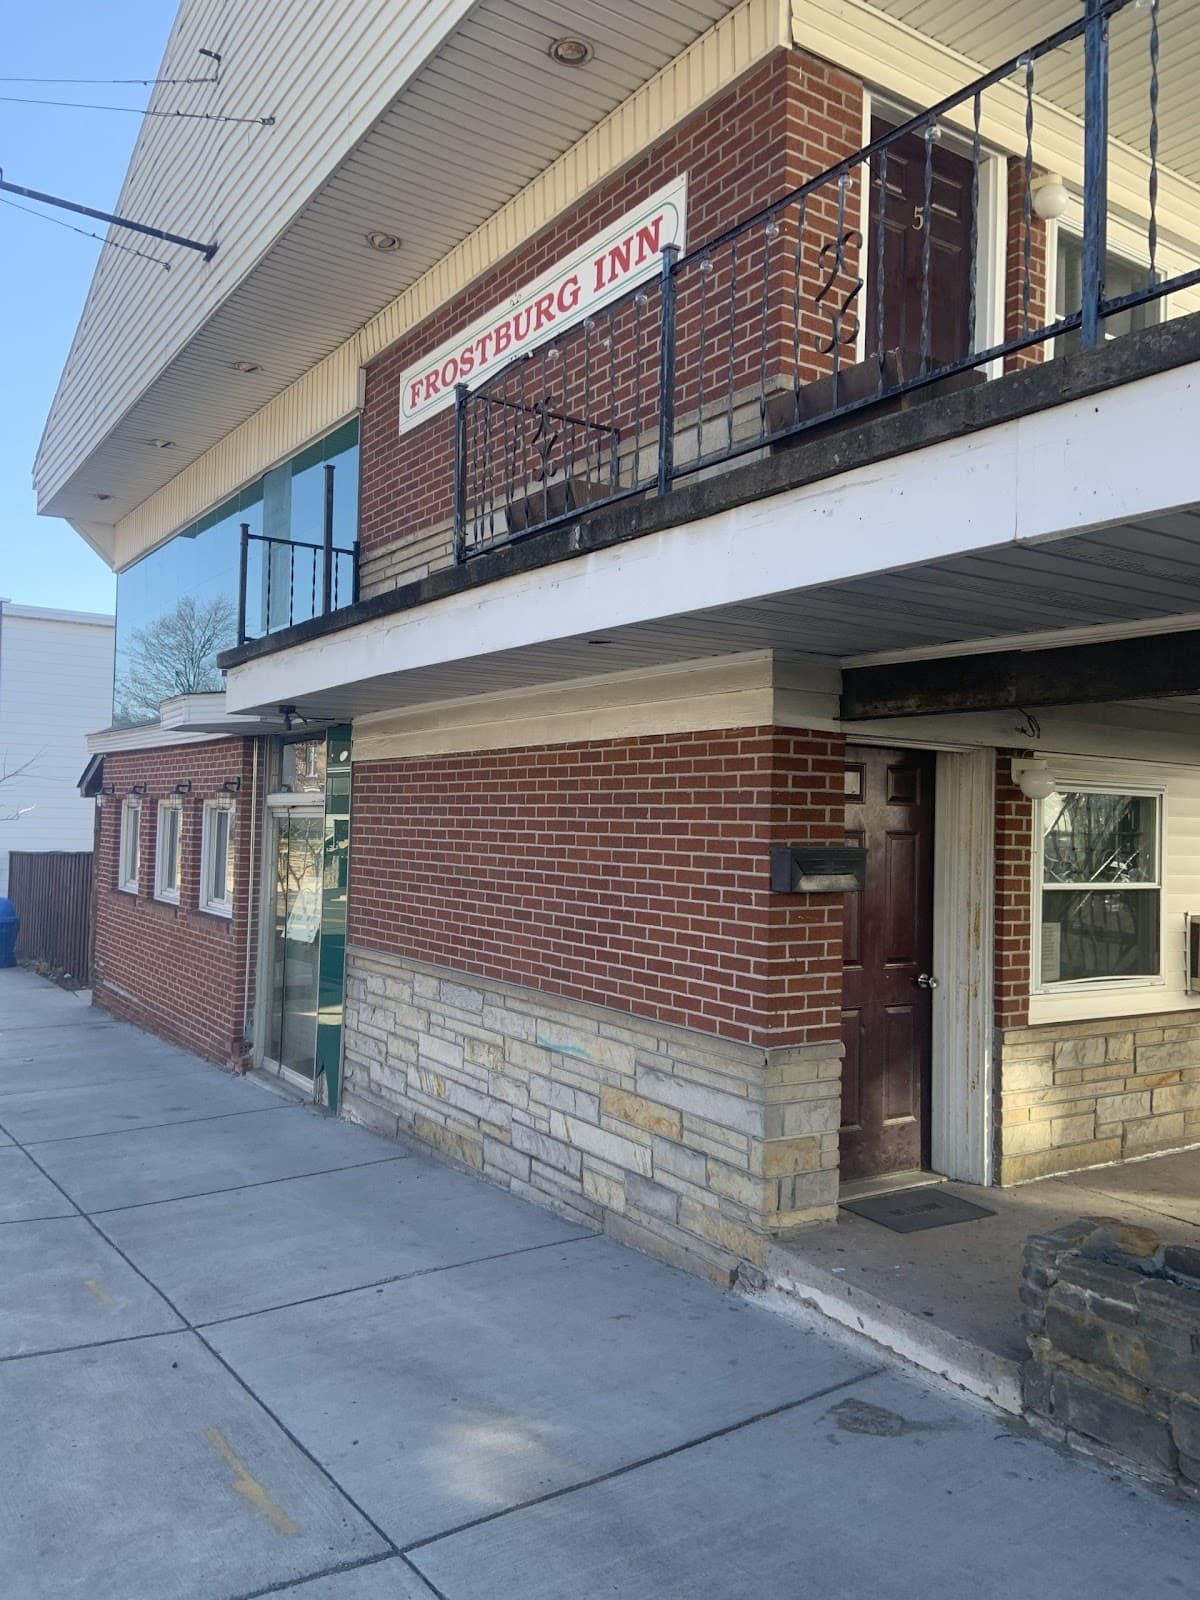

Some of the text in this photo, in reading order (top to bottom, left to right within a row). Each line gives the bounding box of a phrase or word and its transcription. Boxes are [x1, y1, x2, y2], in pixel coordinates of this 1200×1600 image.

[911, 205, 924, 230] 5
[409, 216, 664, 409] FROSTBURG INN
